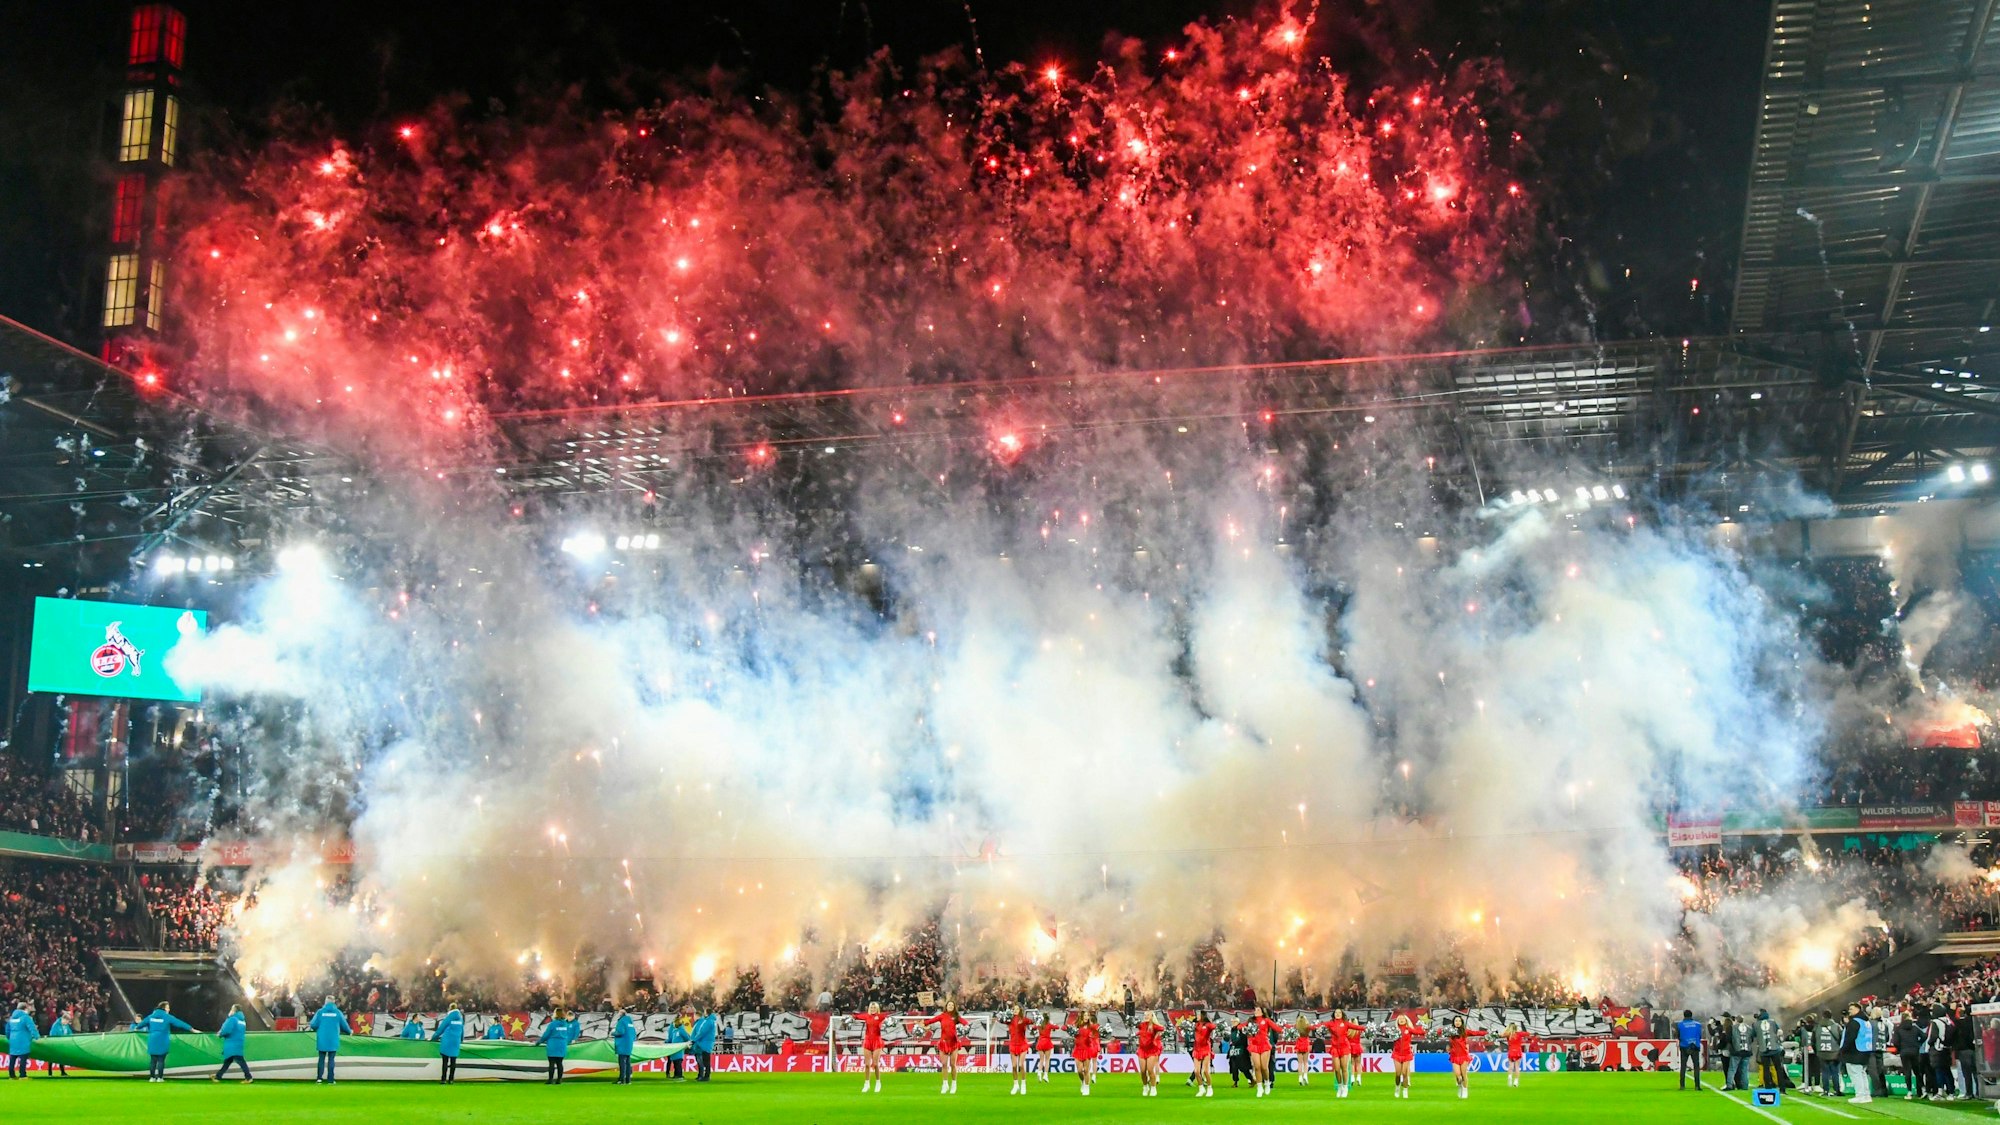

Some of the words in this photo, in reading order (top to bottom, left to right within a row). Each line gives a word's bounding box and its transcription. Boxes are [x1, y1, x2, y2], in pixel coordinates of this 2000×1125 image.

[1820, 1042, 1832, 1051] 25
[638, 1055, 774, 1072] FLYRLARM
[1110, 1057, 1169, 1072] BAK
[1486, 1053, 1540, 1072] Voks
